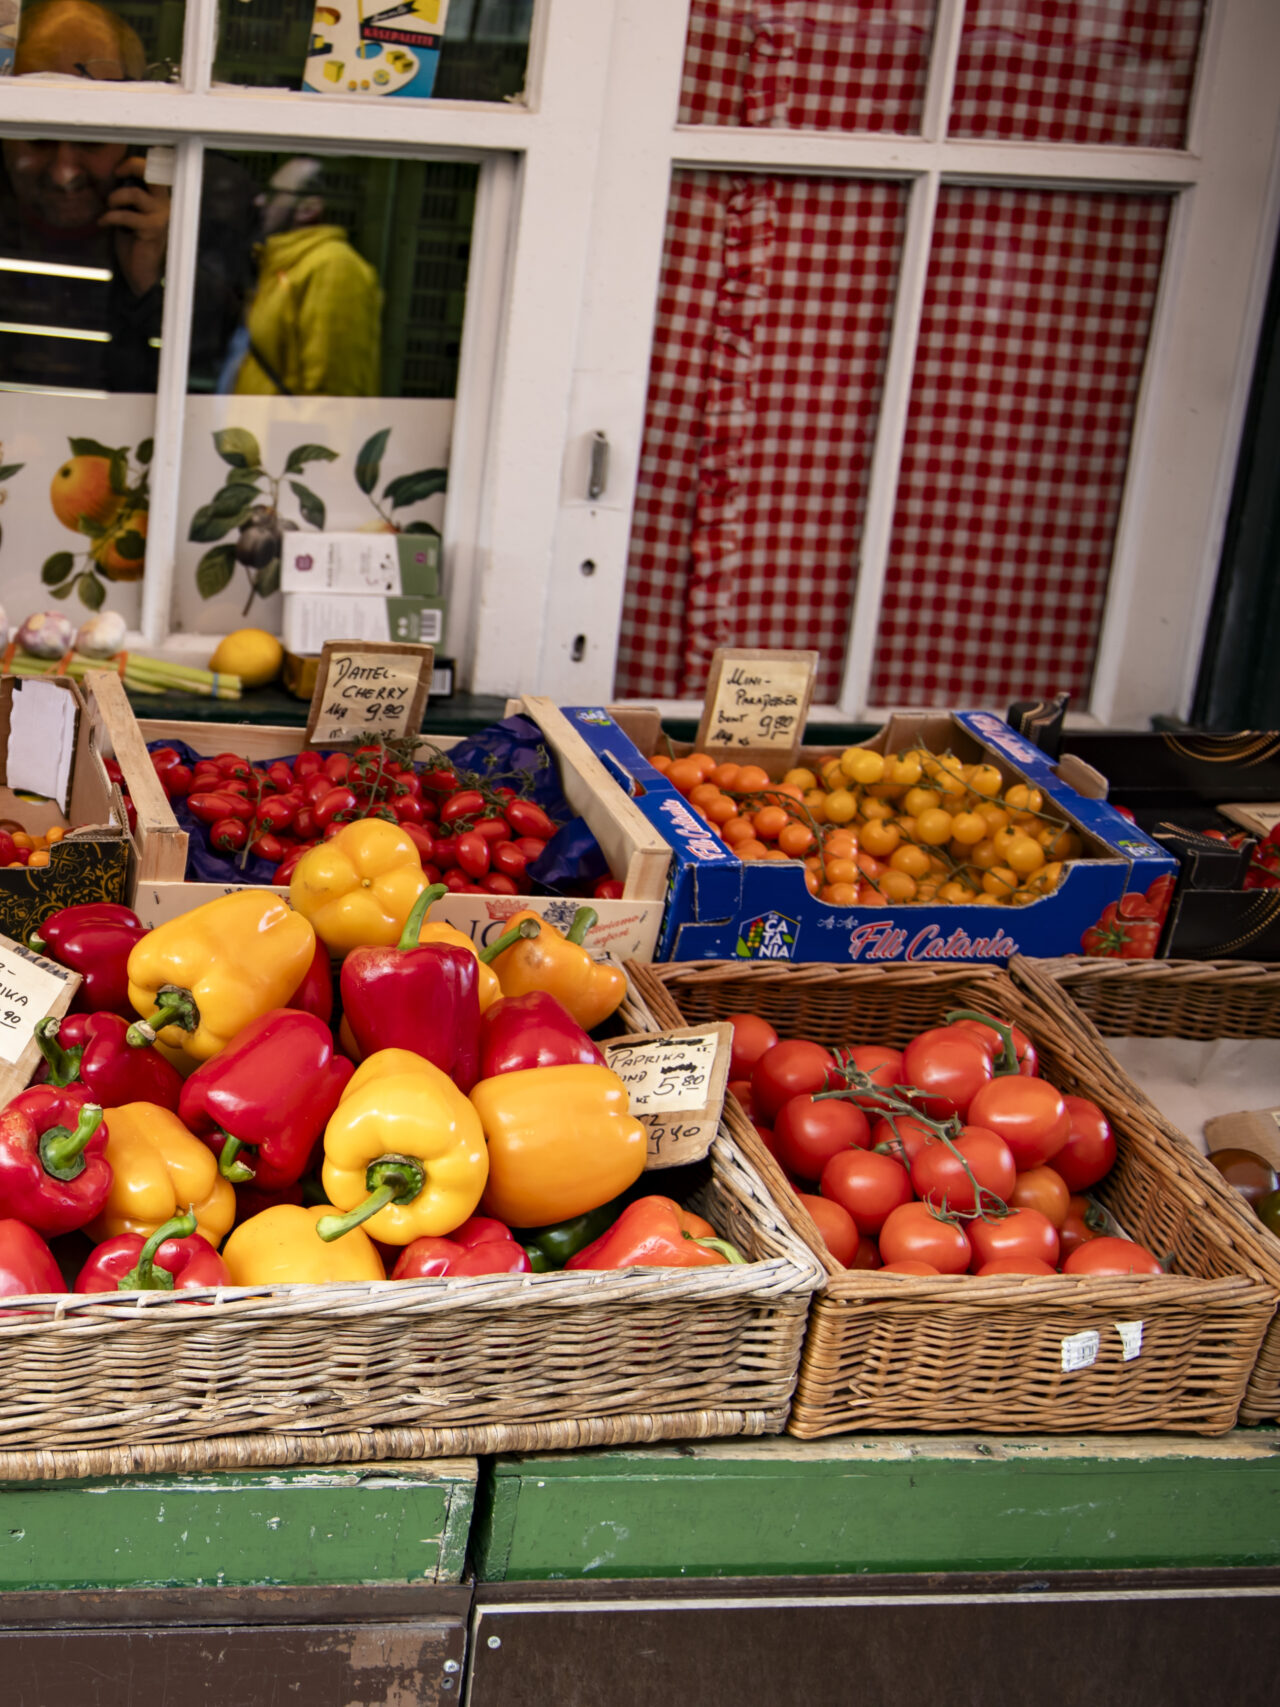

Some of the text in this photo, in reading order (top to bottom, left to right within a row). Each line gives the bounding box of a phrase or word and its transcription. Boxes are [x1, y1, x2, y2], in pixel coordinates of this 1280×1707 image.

[333, 657, 397, 688] DATTEL-
[727, 668, 772, 686] MINI-
[342, 685, 408, 700] CHERRY
[906, 924, 1019, 962] Catania
[608, 1049, 686, 1069] PAPRIKA
[652, 1074, 705, 1096] 5,80
